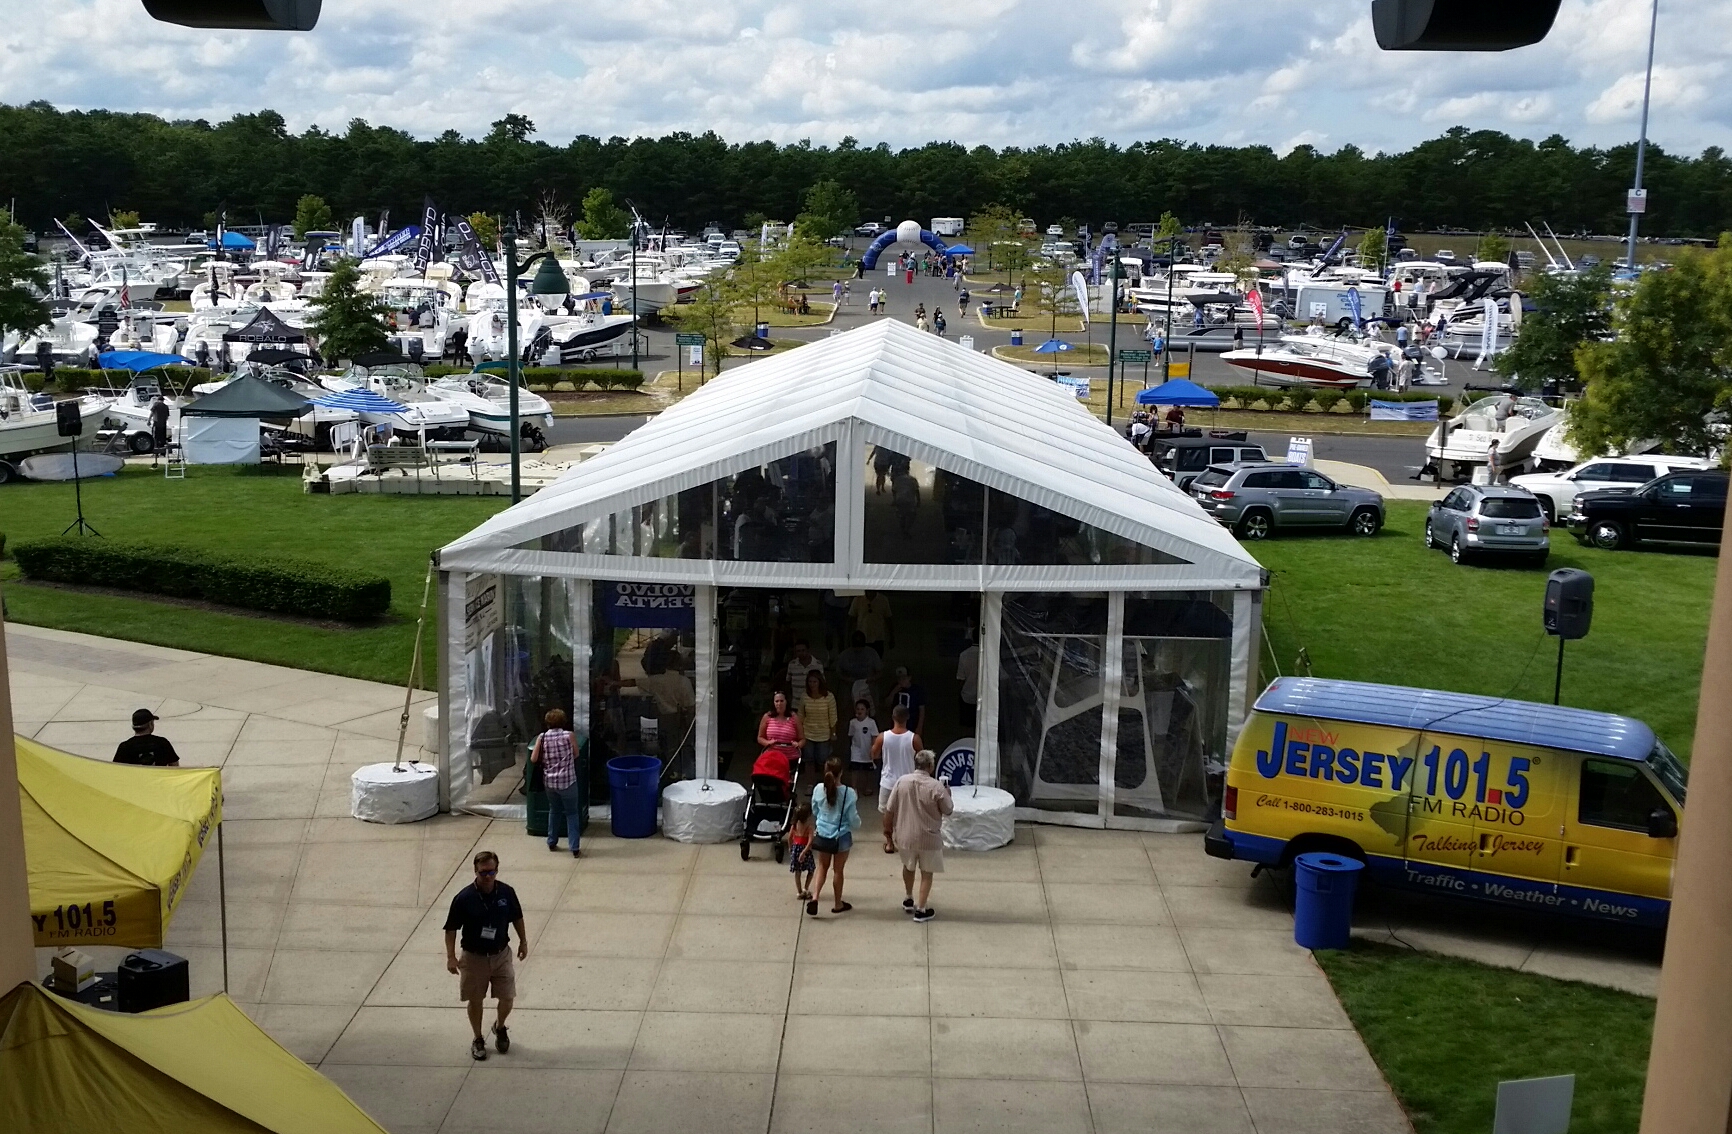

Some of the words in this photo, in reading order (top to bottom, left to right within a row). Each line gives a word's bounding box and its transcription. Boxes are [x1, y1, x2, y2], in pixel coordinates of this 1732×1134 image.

[239, 334, 287, 343] ROBALO
[1287, 451, 1307, 464] BOATS
[1289, 727, 1340, 745] NEW
[1256, 721, 1413, 791] JERSEY
[1256, 794, 1281, 809] Call
[1283, 800, 1364, 822] 1-800-283-1015
[1411, 795, 1442, 814] FM
[1452, 802, 1525, 826] RADIO
[1412, 834, 1479, 855] Talking
[1490, 834, 1546, 857] Jersey
[1406, 869, 1467, 891] Traffic
[1484, 882, 1566, 907] Weather
[1583, 898, 1639, 919] News
[53, 900, 117, 931] 101.5
[50, 929, 69, 939] FM
[75, 926, 117, 937] RADIO
